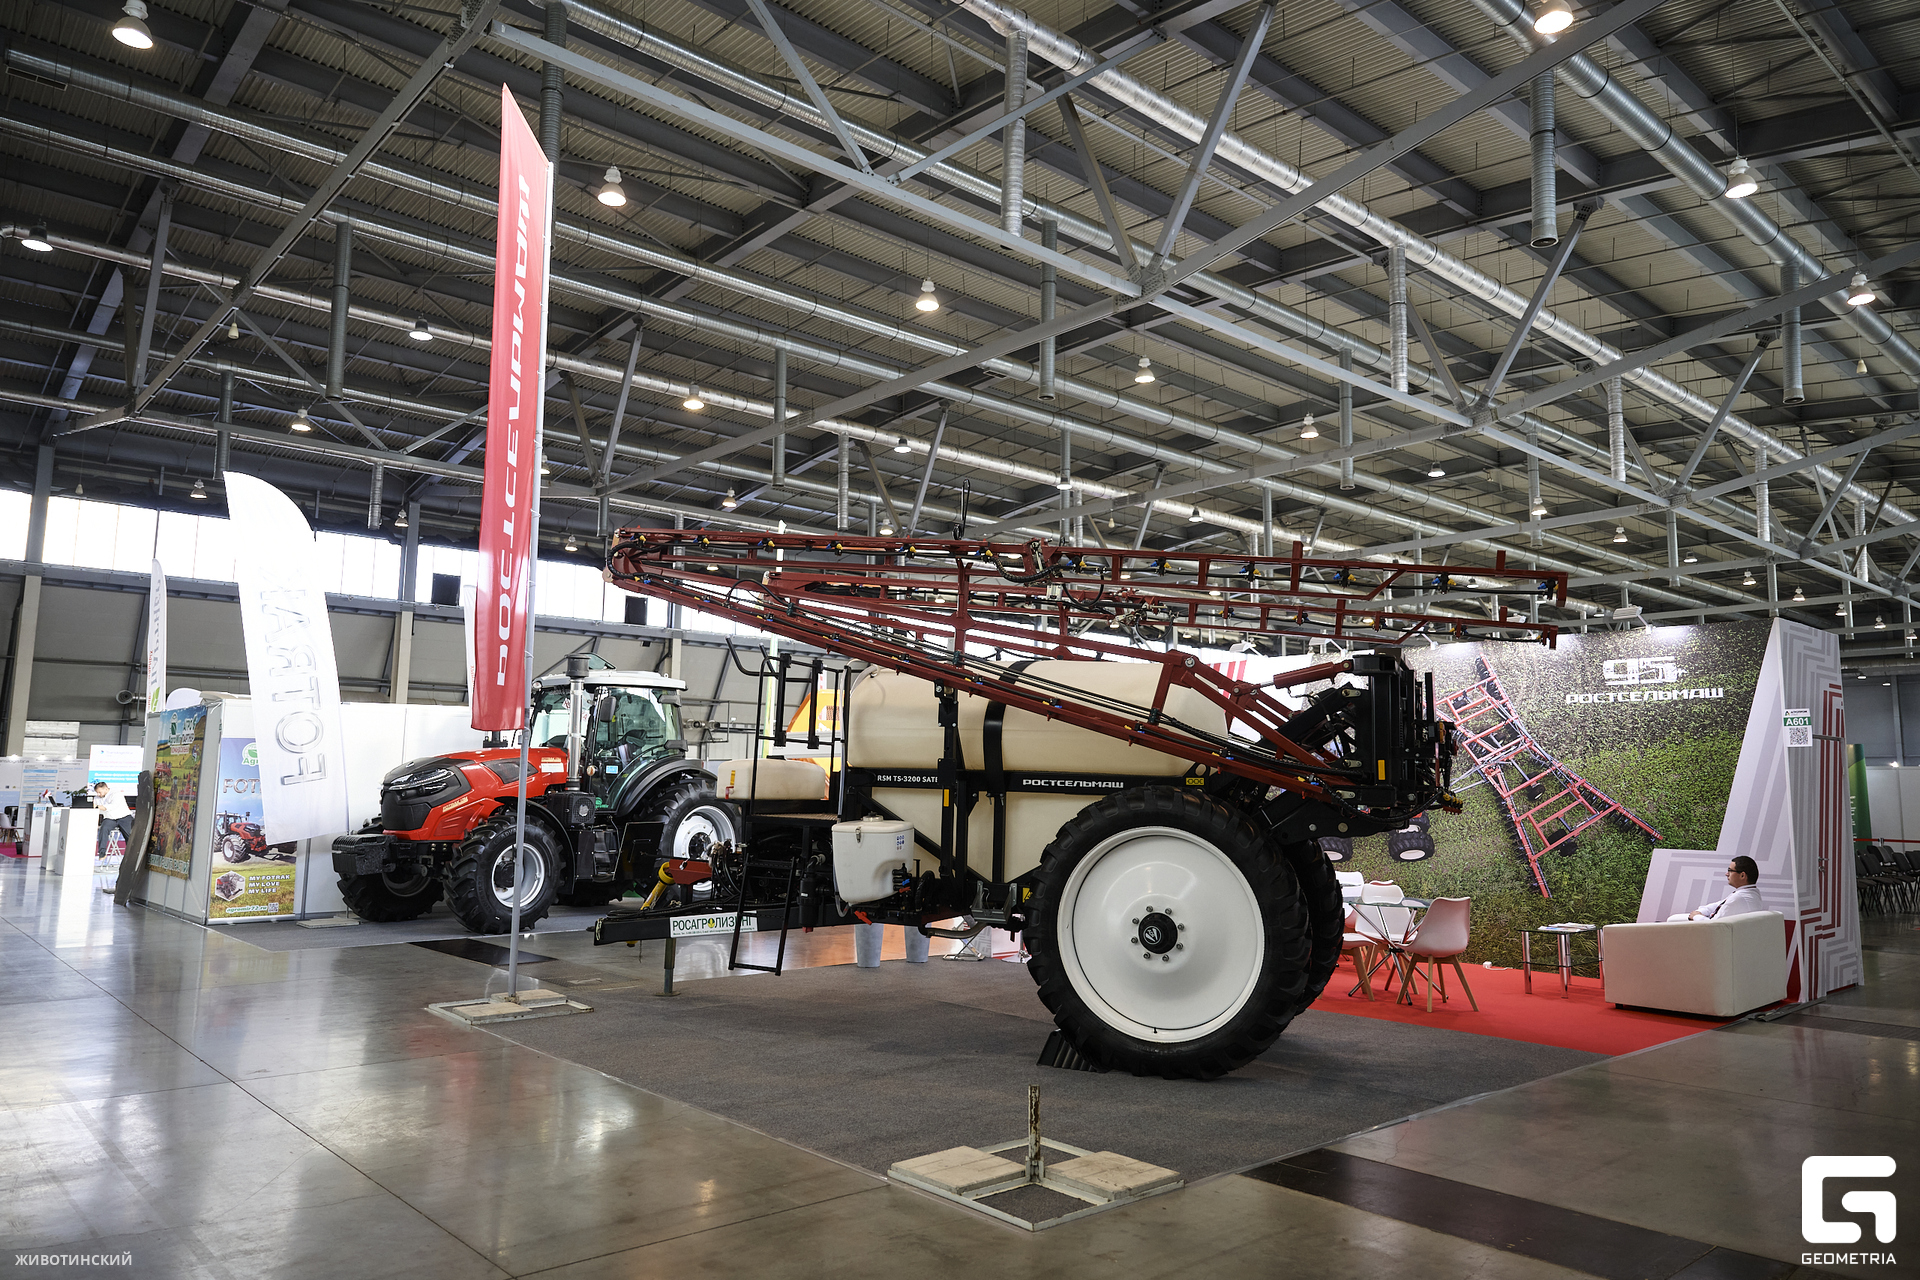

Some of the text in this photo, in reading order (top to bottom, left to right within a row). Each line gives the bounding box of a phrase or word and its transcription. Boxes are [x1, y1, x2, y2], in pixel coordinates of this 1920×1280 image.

[1565, 687, 1724, 705] РОСТСЕЛЬМАШ
[223, 778, 262, 794] FOT
[877, 774, 892, 782] RSM
[893, 775, 921, 783] TS-3200
[1022, 778, 1124, 789] РОСТСЕЛЬМАШ
[672, 915, 752, 931] РОСАГРОЛИЗНГ
